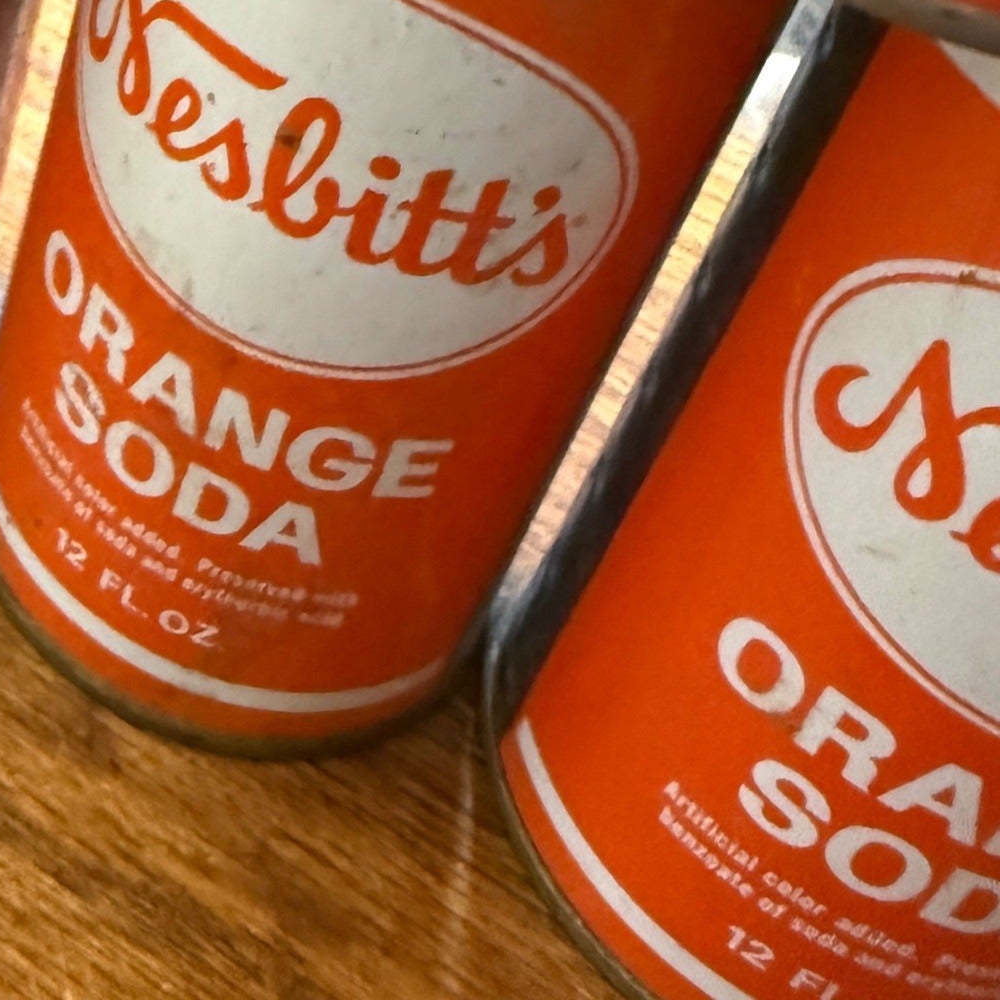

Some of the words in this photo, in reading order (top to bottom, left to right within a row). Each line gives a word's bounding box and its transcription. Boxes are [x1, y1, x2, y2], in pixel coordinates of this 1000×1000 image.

[44, 229, 454, 499] ORANGE
[55, 362, 321, 566] SODA
[56, 527, 88, 572] 12
[717, 616, 1000, 856] ORA
[758, 897, 788, 918] of
[762, 871, 828, 917] color
[728, 925, 775, 972] 12
